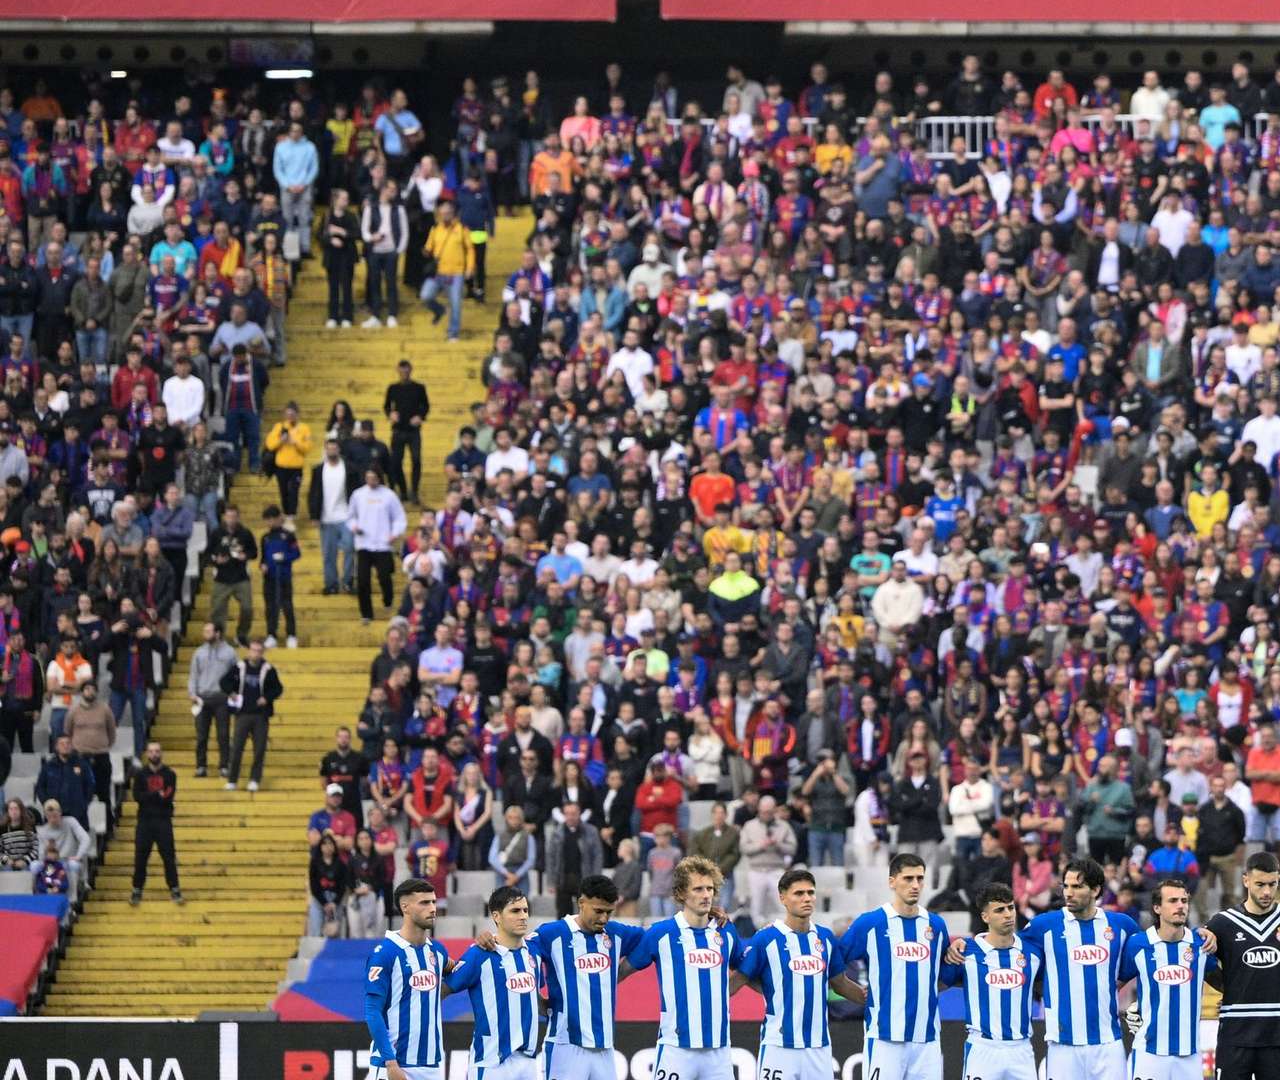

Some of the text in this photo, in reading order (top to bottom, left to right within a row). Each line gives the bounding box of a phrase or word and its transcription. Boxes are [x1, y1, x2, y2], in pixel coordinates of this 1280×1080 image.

[896, 945, 924, 957] DANI
[1074, 949, 1102, 960] DANI
[578, 957, 605, 969] DANI
[688, 952, 716, 964] DANI
[1246, 951, 1276, 964] DANI
[793, 960, 821, 971] DANI
[412, 974, 436, 987] DANI
[990, 972, 1018, 984] DANI
[1157, 969, 1186, 981] DANI
[510, 977, 534, 990] DANI
[46, 1058, 187, 1080] DANA
